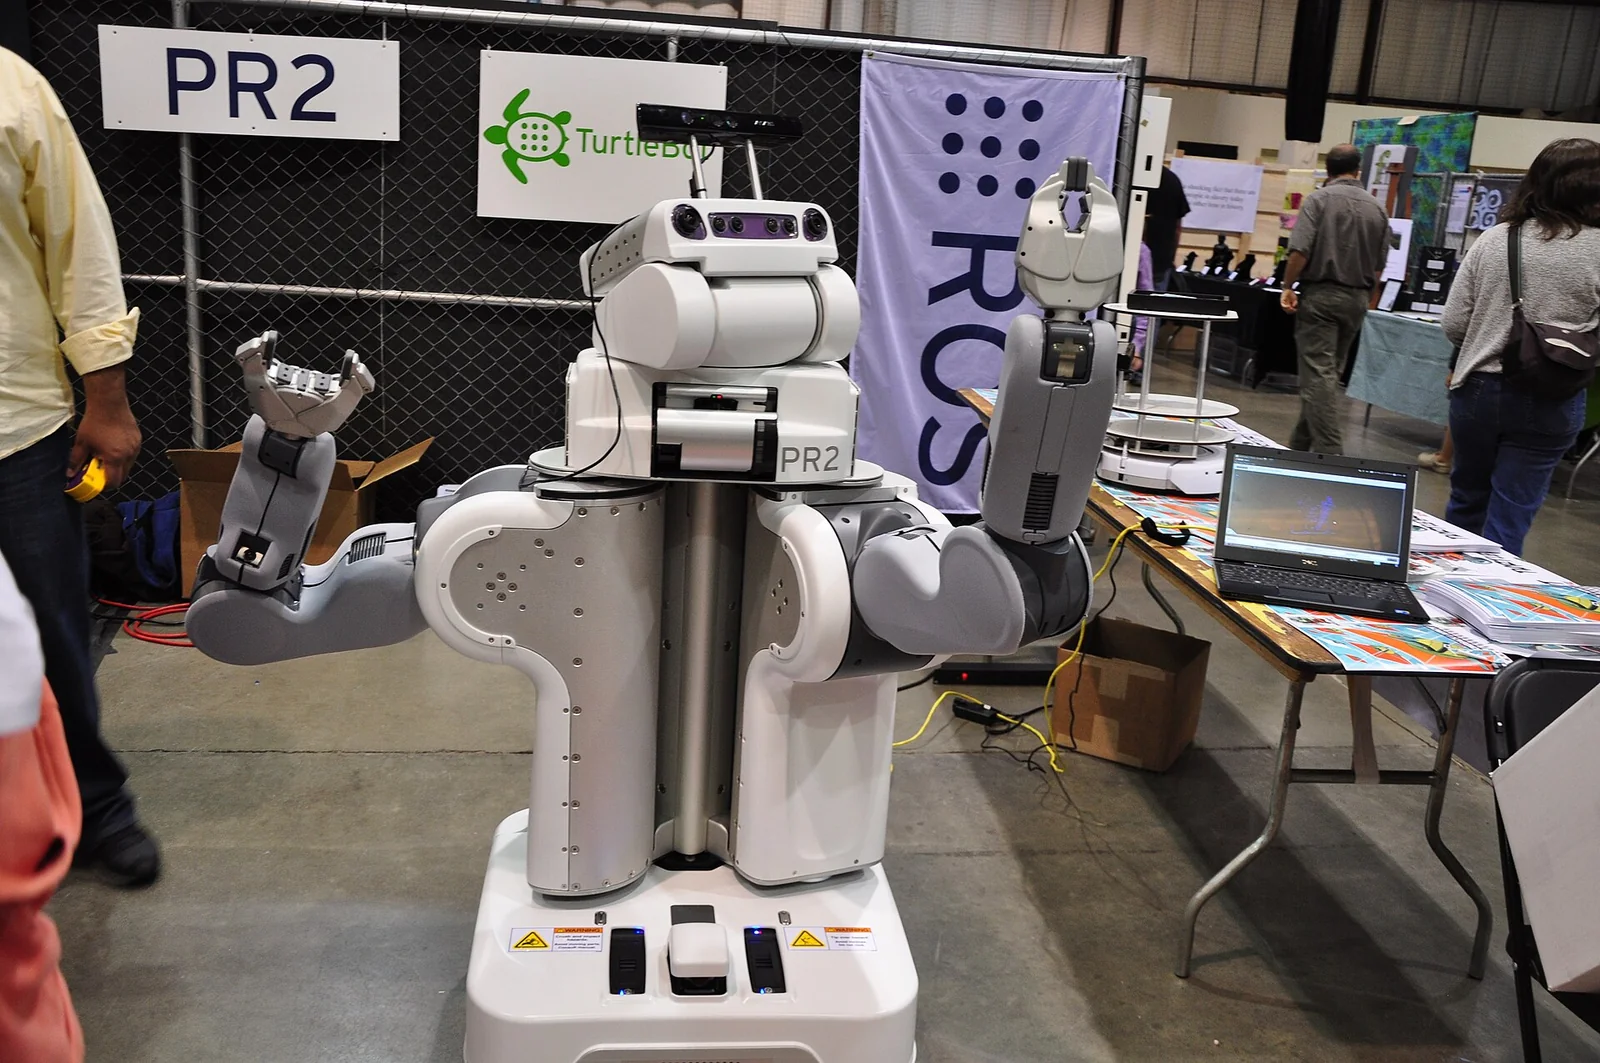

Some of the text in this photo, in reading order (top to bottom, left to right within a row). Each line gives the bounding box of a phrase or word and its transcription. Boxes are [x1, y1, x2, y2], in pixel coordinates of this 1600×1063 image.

[166, 47, 337, 122] PR2
[918, 230, 1025, 487] ROS
[781, 445, 839, 472] PR2
